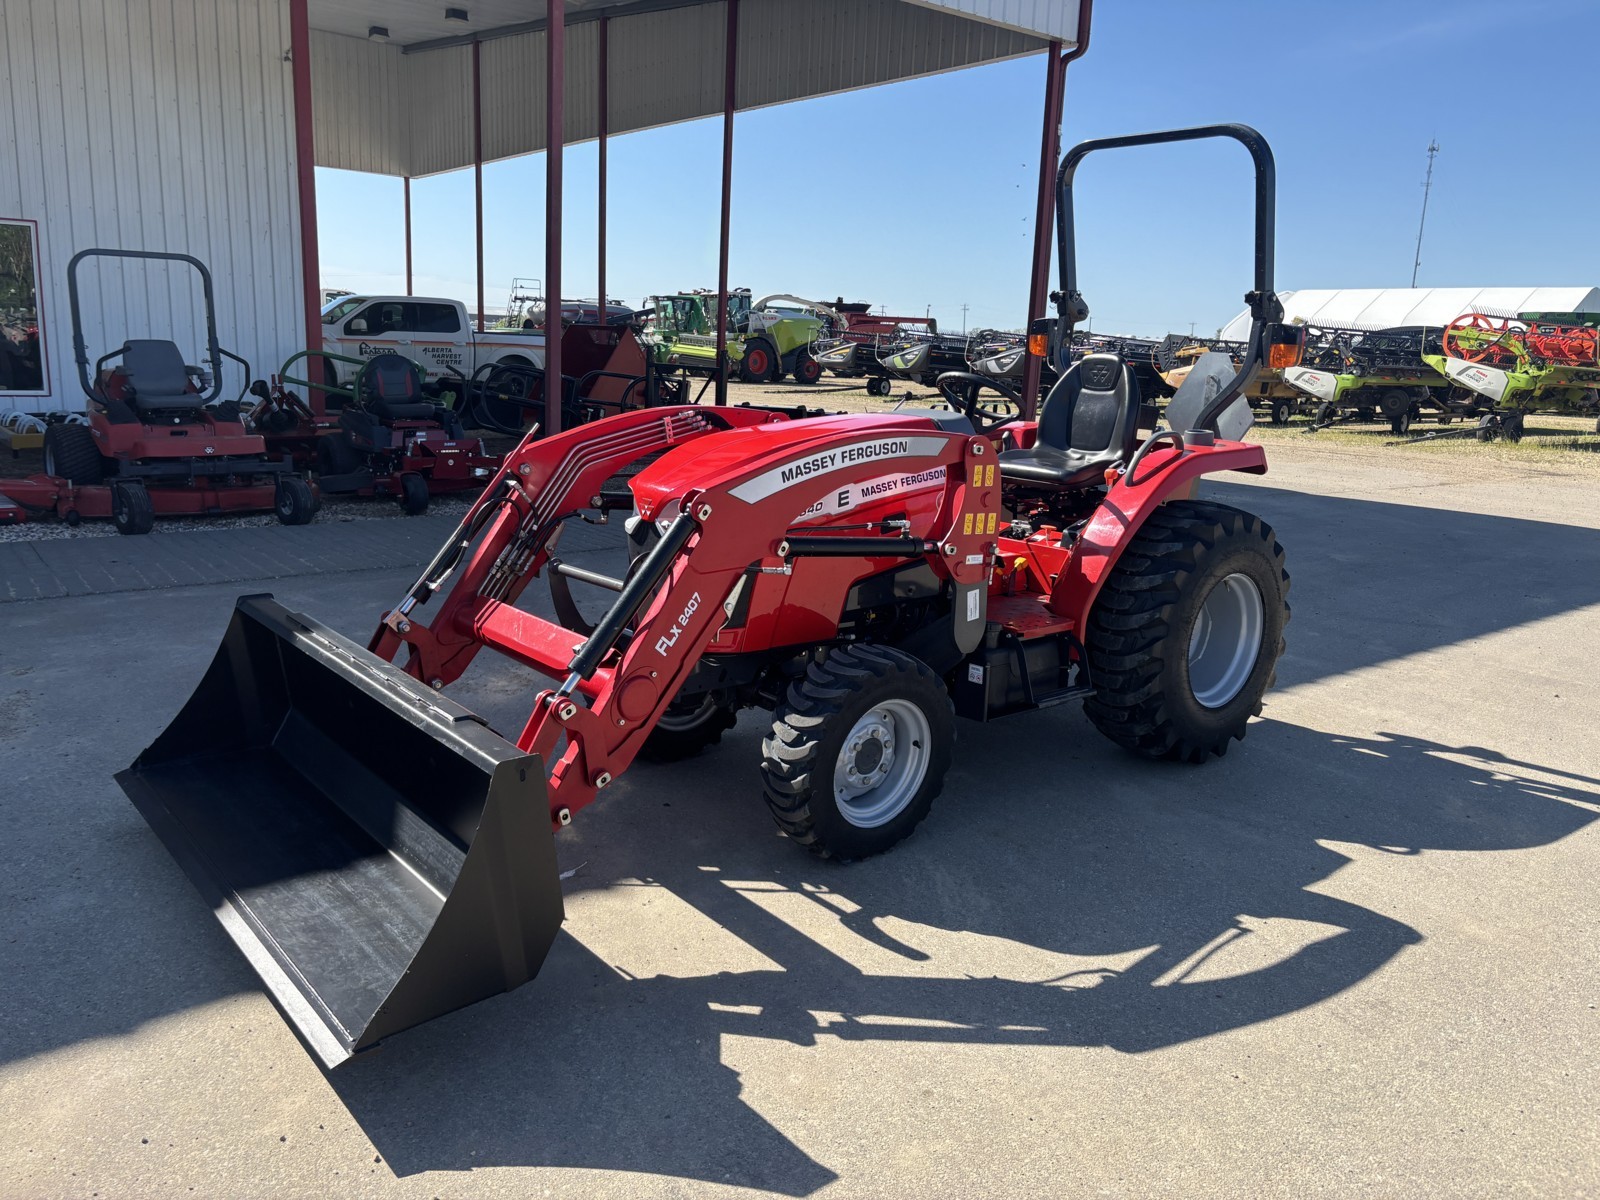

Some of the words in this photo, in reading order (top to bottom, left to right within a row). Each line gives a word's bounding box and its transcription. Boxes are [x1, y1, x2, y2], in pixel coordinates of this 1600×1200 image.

[422, 347, 452, 356] ALBERTA
[781, 453, 836, 483] MASSEY
[841, 441, 907, 464] FERGUSON
[861, 479, 899, 498] MASSEY
[900, 468, 947, 489] FERGUSON
[837, 490, 850, 508] E
[654, 623, 683, 657] FLX
[677, 591, 702, 627] 2407
